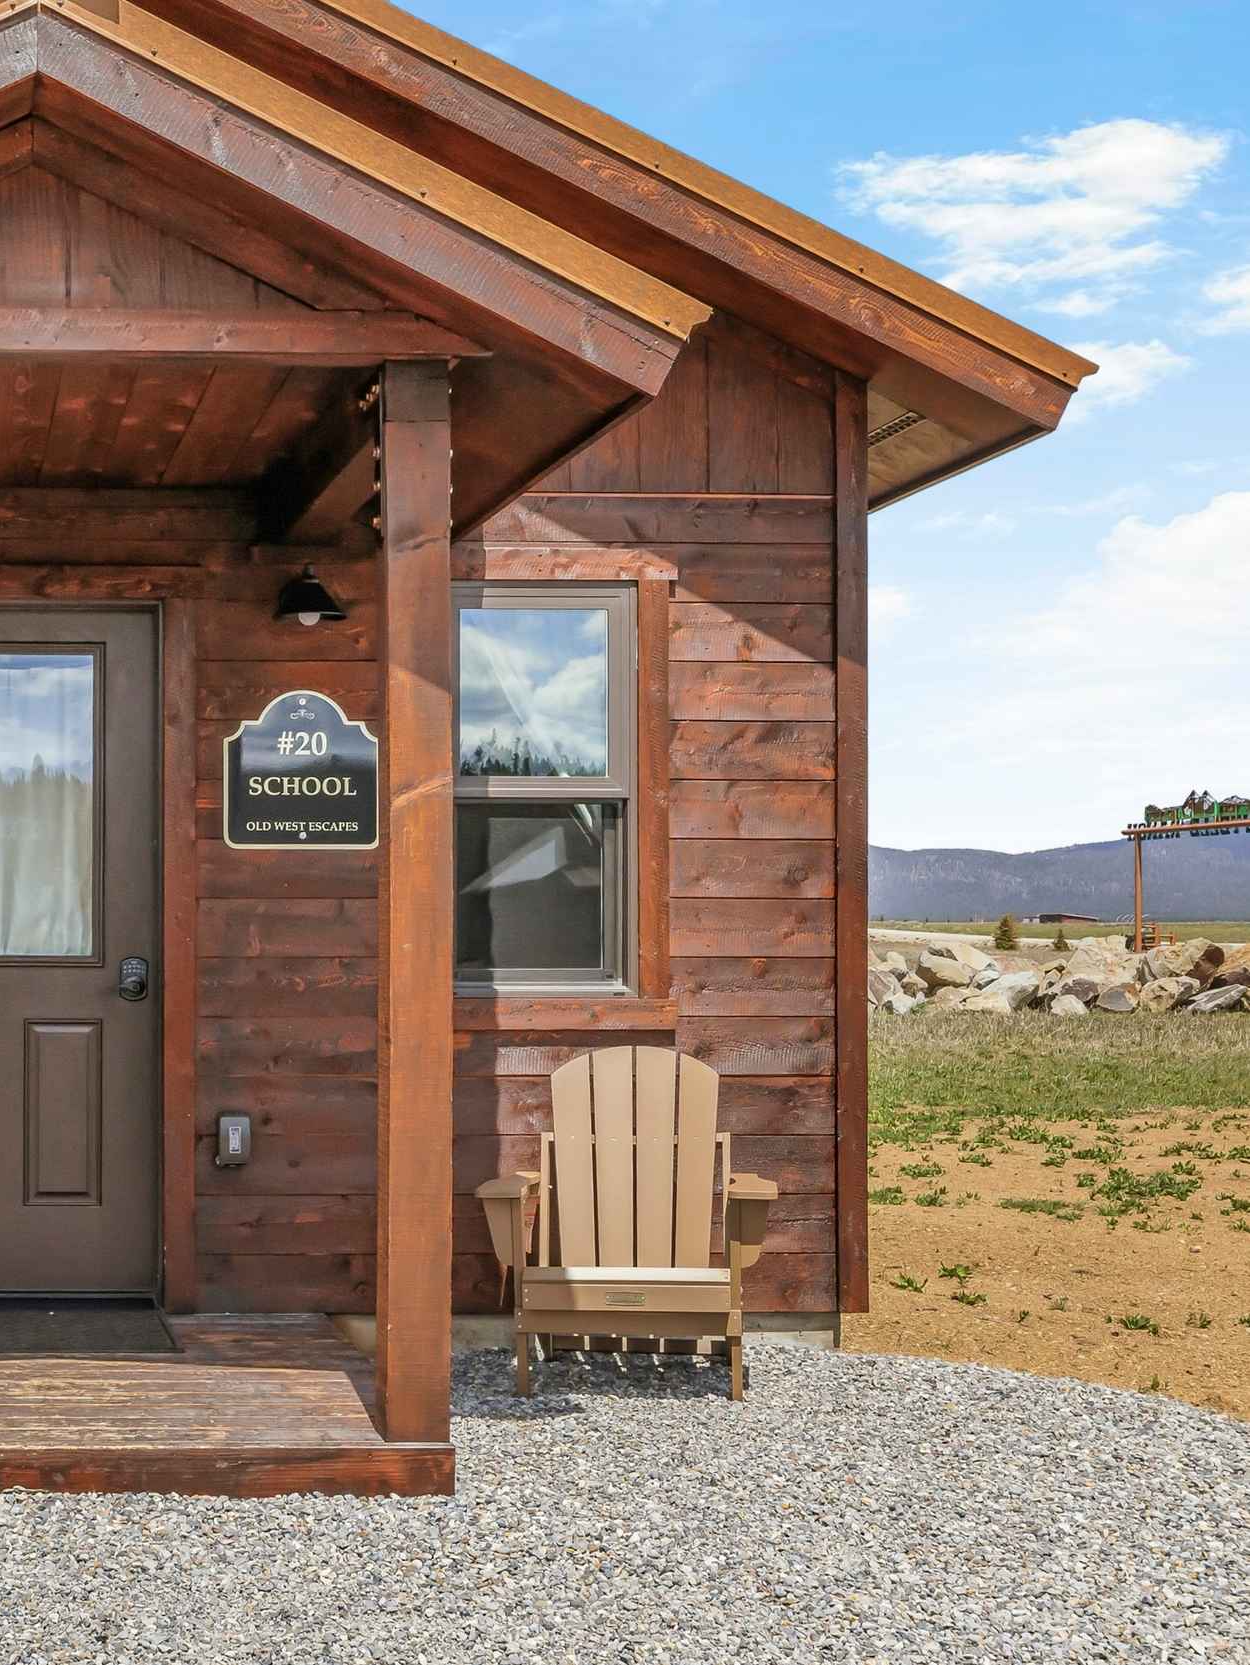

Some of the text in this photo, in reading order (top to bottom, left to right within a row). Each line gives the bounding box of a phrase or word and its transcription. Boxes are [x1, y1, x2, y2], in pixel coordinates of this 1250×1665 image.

[277, 731, 327, 756] #20
[248, 776, 357, 796] SCHOOL
[246, 821, 359, 832] OLD WEST ESCAPES
